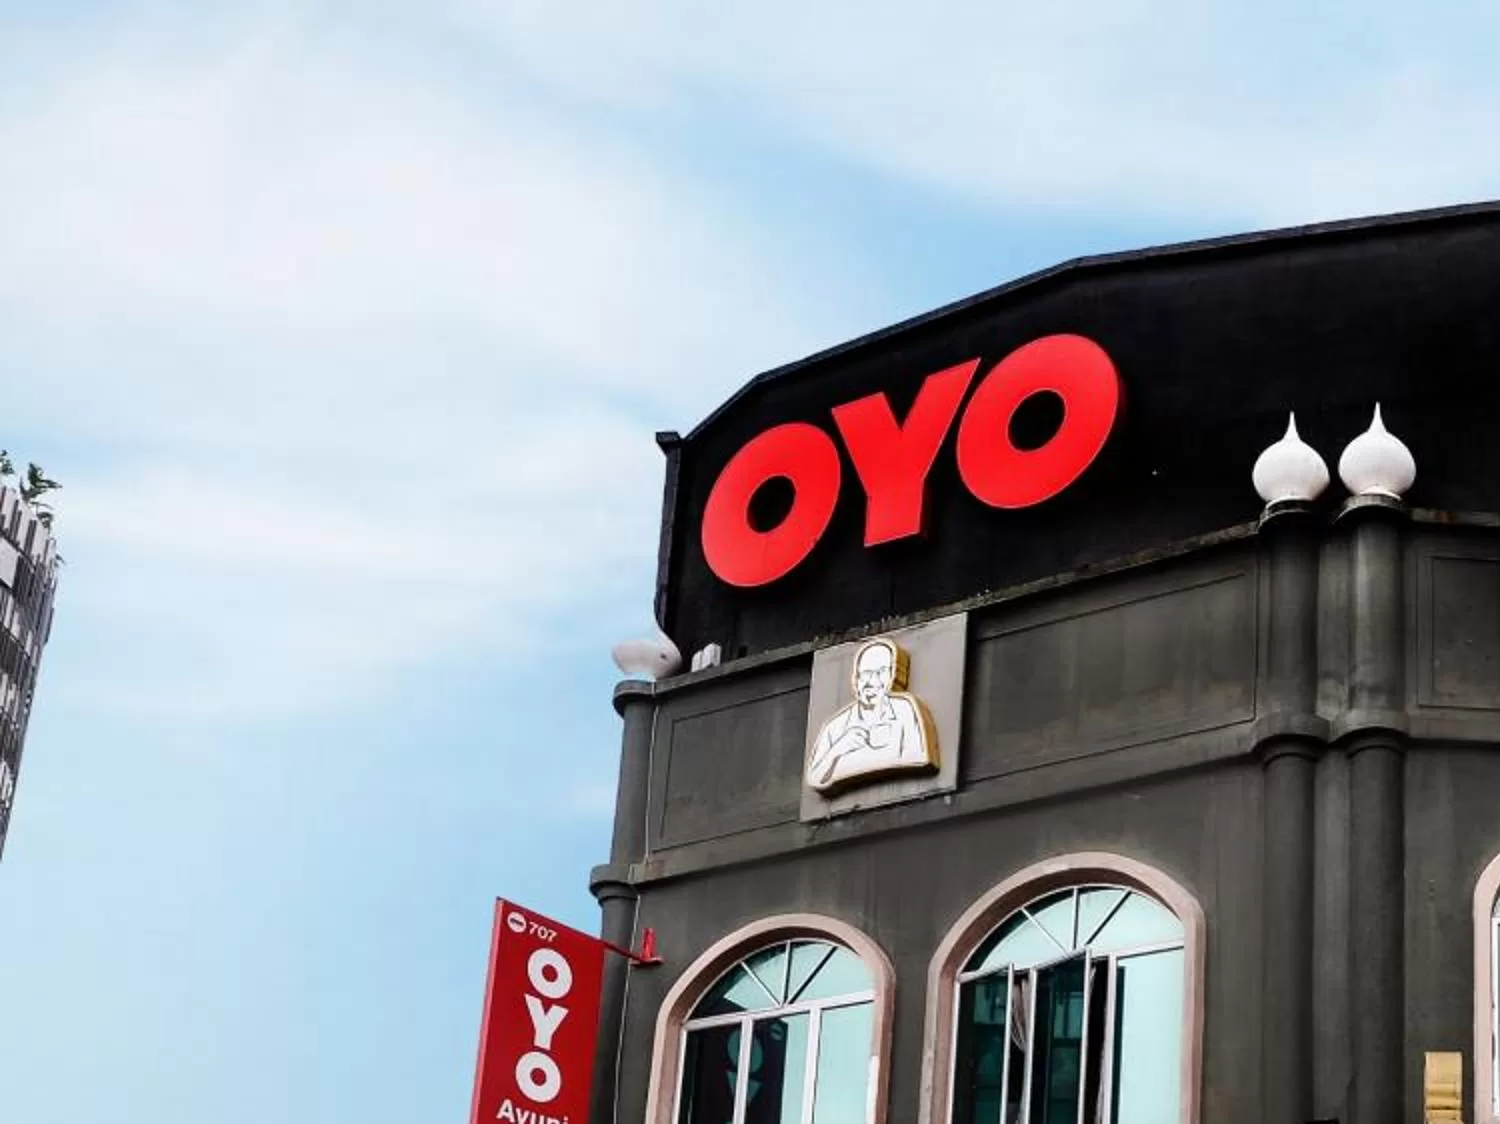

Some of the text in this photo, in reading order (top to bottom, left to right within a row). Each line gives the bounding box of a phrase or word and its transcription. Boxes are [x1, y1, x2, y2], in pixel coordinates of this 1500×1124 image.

[702, 333, 1119, 587] OYO
[529, 921, 558, 942] 707
[515, 948, 573, 1103] OYO
